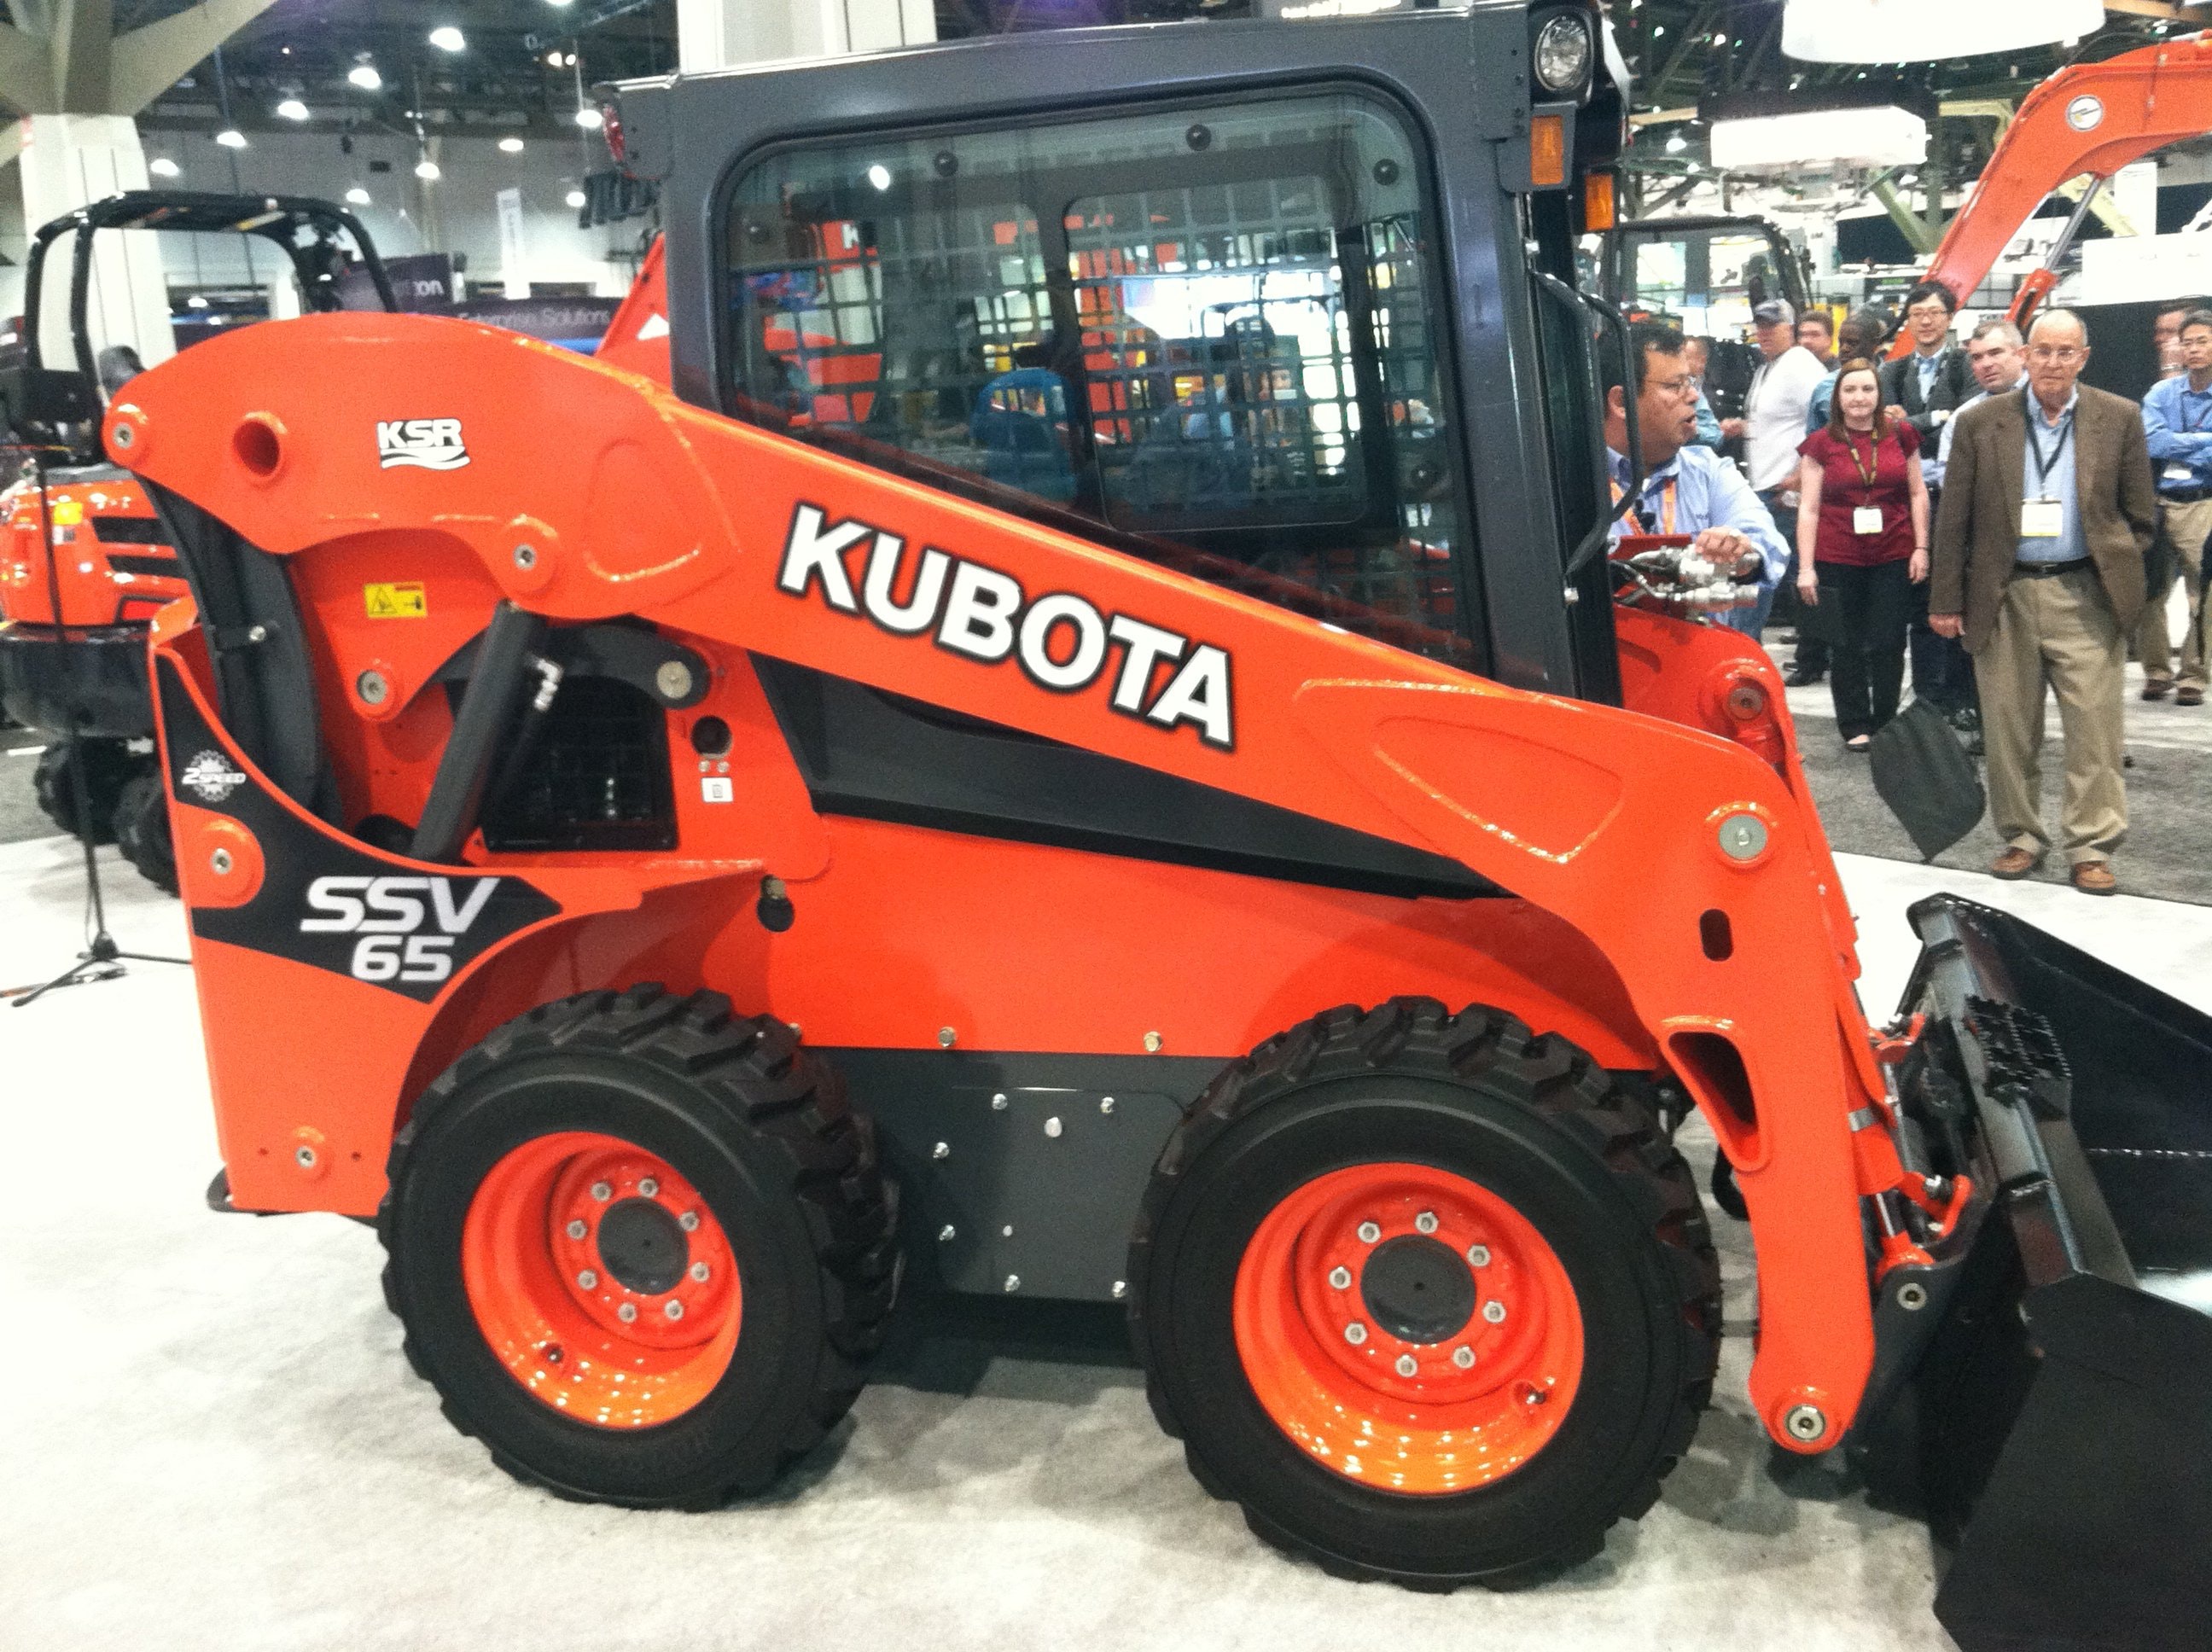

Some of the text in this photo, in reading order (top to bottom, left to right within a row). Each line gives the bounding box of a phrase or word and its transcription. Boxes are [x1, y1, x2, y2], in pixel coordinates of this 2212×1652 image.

[377, 418, 463, 449] KSR
[778, 502, 1235, 749] KUBOTA
[300, 875, 500, 933] SSV
[352, 935, 455, 981] 65
